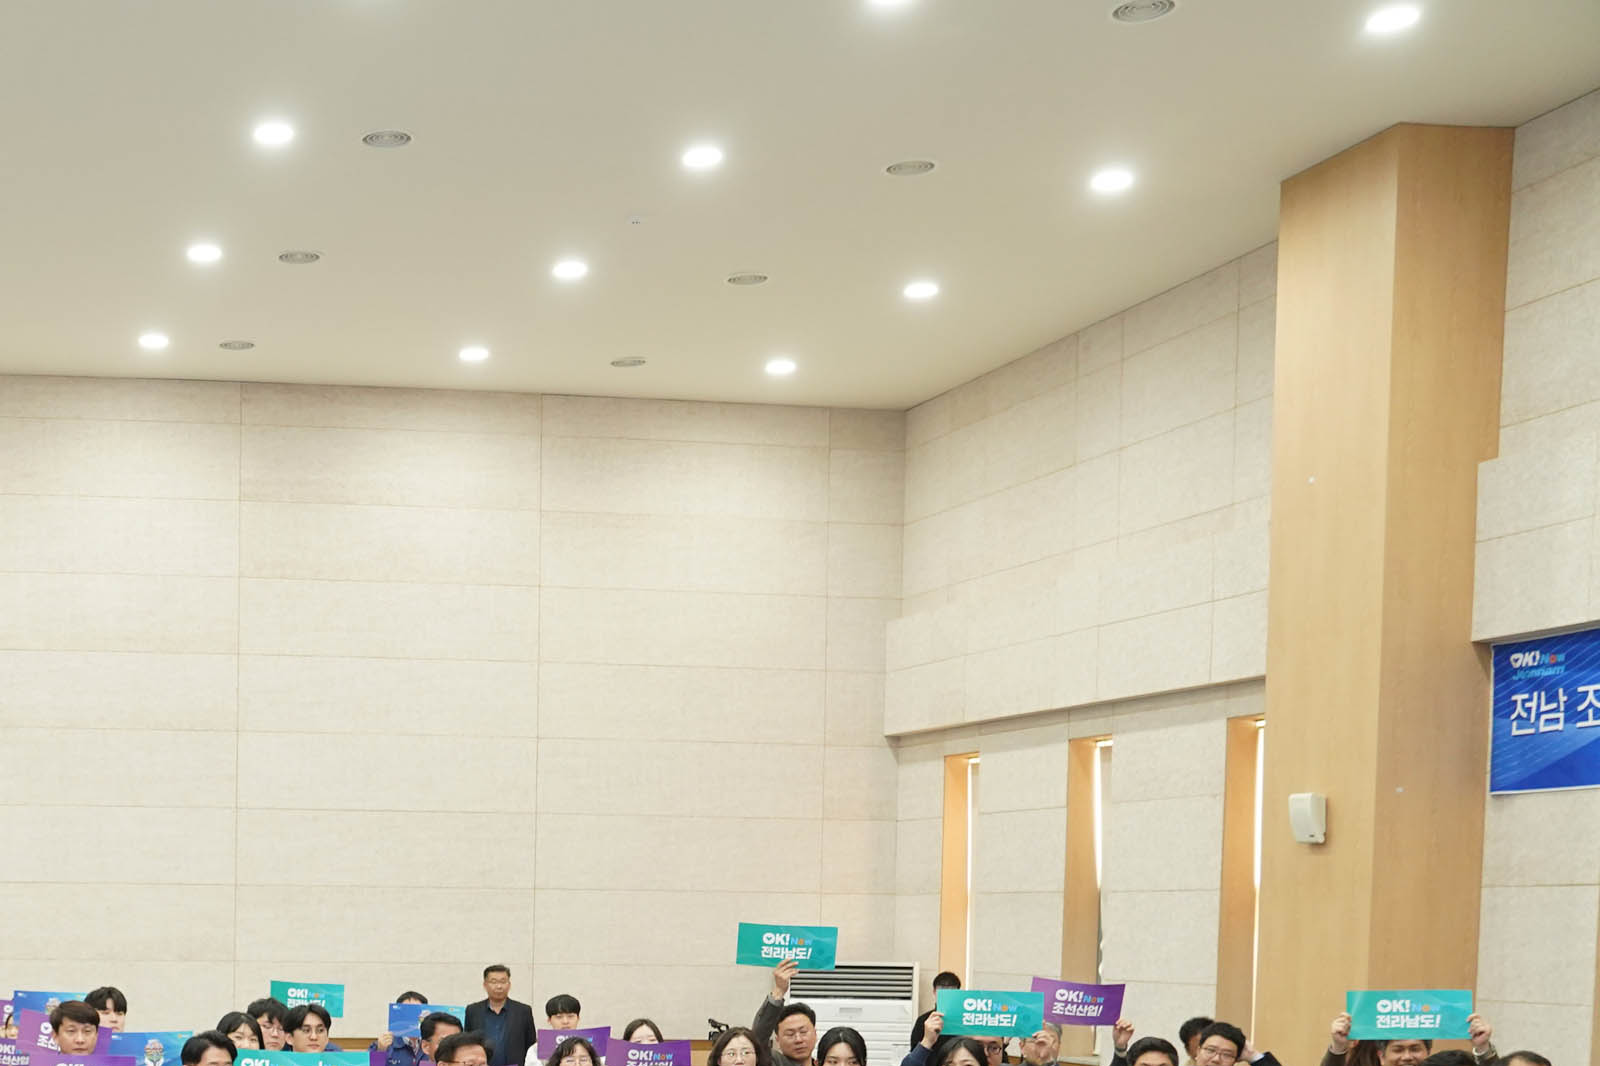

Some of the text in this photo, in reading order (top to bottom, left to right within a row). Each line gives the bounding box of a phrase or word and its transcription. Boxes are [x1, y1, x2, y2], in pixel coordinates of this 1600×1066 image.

[1510, 650, 1566, 669] OK! Now
[1510, 688, 1568, 736] 전남
[762, 932, 813, 946] OK! Now
[761, 946, 812, 960] 전라남도!
[287, 987, 308, 998] OK!
[1055, 988, 1105, 1004] OK! Now
[963, 998, 1017, 1013] OK! Now
[1052, 1002, 1103, 1018] 조선산업!
[1376, 999, 1411, 1013] OK!
[962, 1012, 1017, 1027] 전라남도!
[1376, 1014, 1441, 1029] 전라남도!
[628, 1049, 674, 1061] OK! Now
